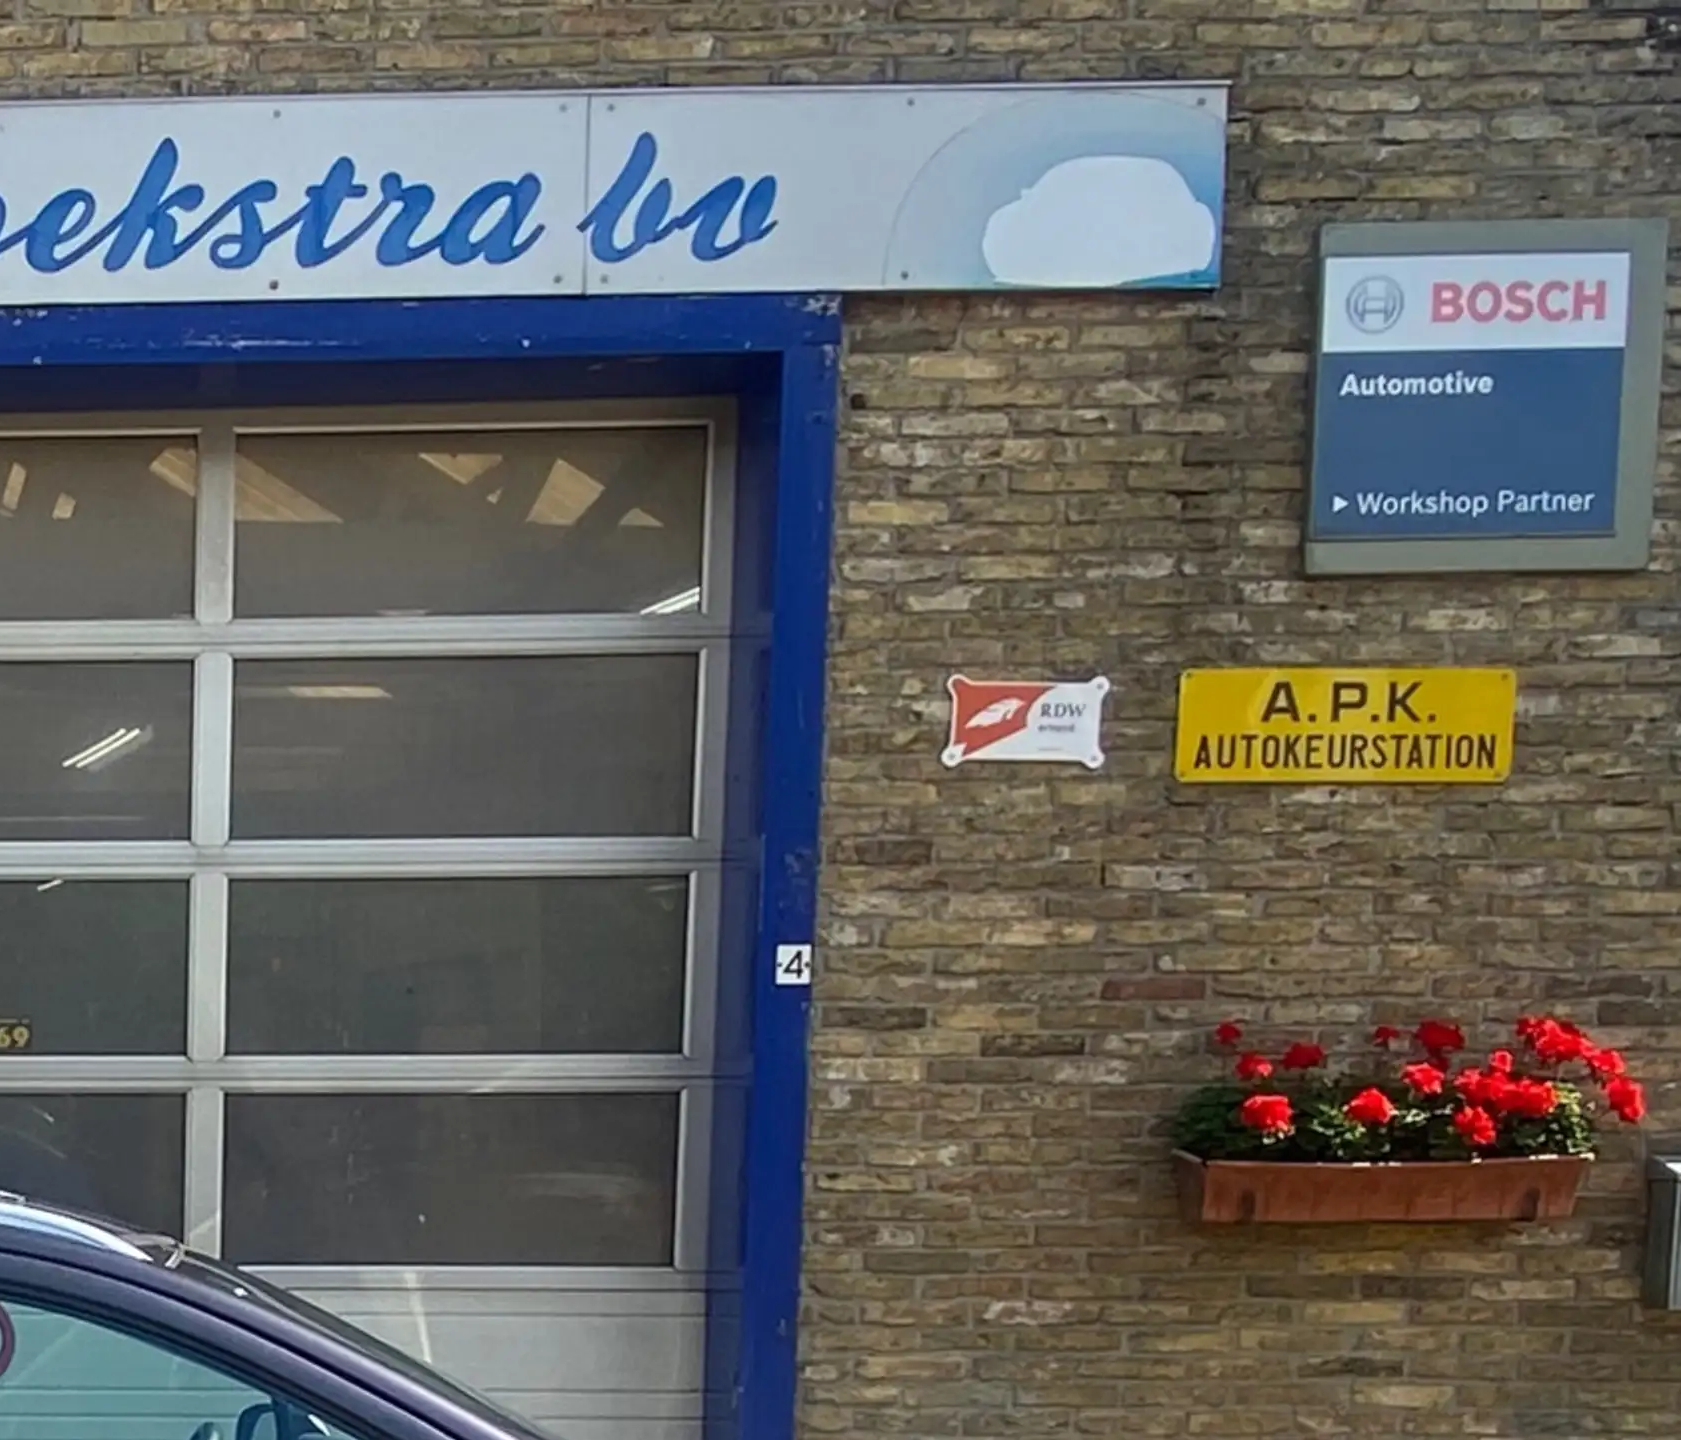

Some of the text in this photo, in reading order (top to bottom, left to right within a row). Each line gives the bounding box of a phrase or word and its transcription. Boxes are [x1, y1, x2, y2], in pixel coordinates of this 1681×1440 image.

[578, 131, 780, 263] bv
[1431, 280, 1607, 323] BOSCH
[1339, 370, 1494, 396] Automotive
[1356, 489, 1595, 518] Workshop Partner
[1039, 702, 1087, 718] RDW
[1260, 681, 1437, 722] A.P.K.
[1192, 733, 1497, 770] AUTOKEURSTATION
[782, 950, 803, 979] 4
